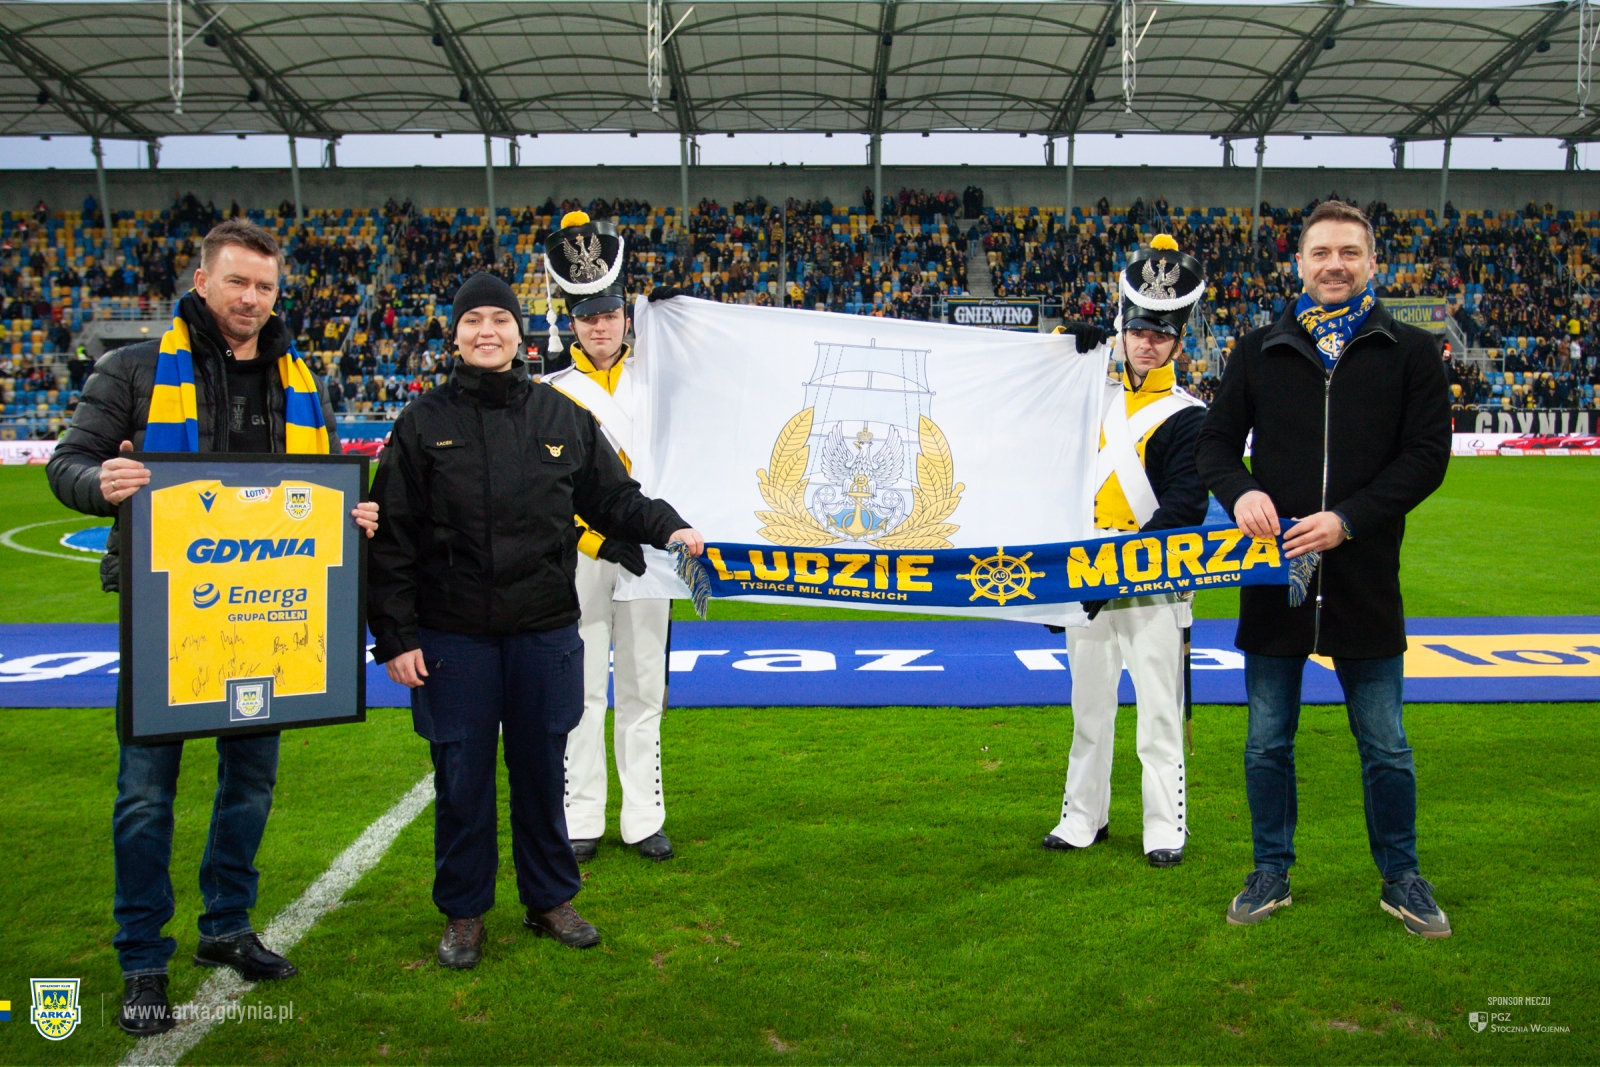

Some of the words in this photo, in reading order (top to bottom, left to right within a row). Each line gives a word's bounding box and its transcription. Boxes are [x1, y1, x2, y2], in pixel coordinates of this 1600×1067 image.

[954, 306, 1034, 325] GNIEWINO
[1475, 411, 1590, 435] GDYNIA
[245, 488, 265, 498] LOTTO
[186, 537, 315, 564] GDYNIA
[1066, 528, 1282, 588] MORZA
[706, 547, 934, 592] LUDZIE
[740, 581, 795, 593] TYSIĄCE
[799, 584, 824, 595] MIL
[827, 587, 908, 601] MORSKICH
[1119, 586, 1129, 594] Z
[1133, 581, 1174, 593] ARKĄ
[1176, 578, 1191, 587] W
[1195, 573, 1241, 586] SERCU
[228, 586, 308, 608] Energa
[228, 613, 266, 622] GRUPA
[268, 610, 306, 621] ORLEN
